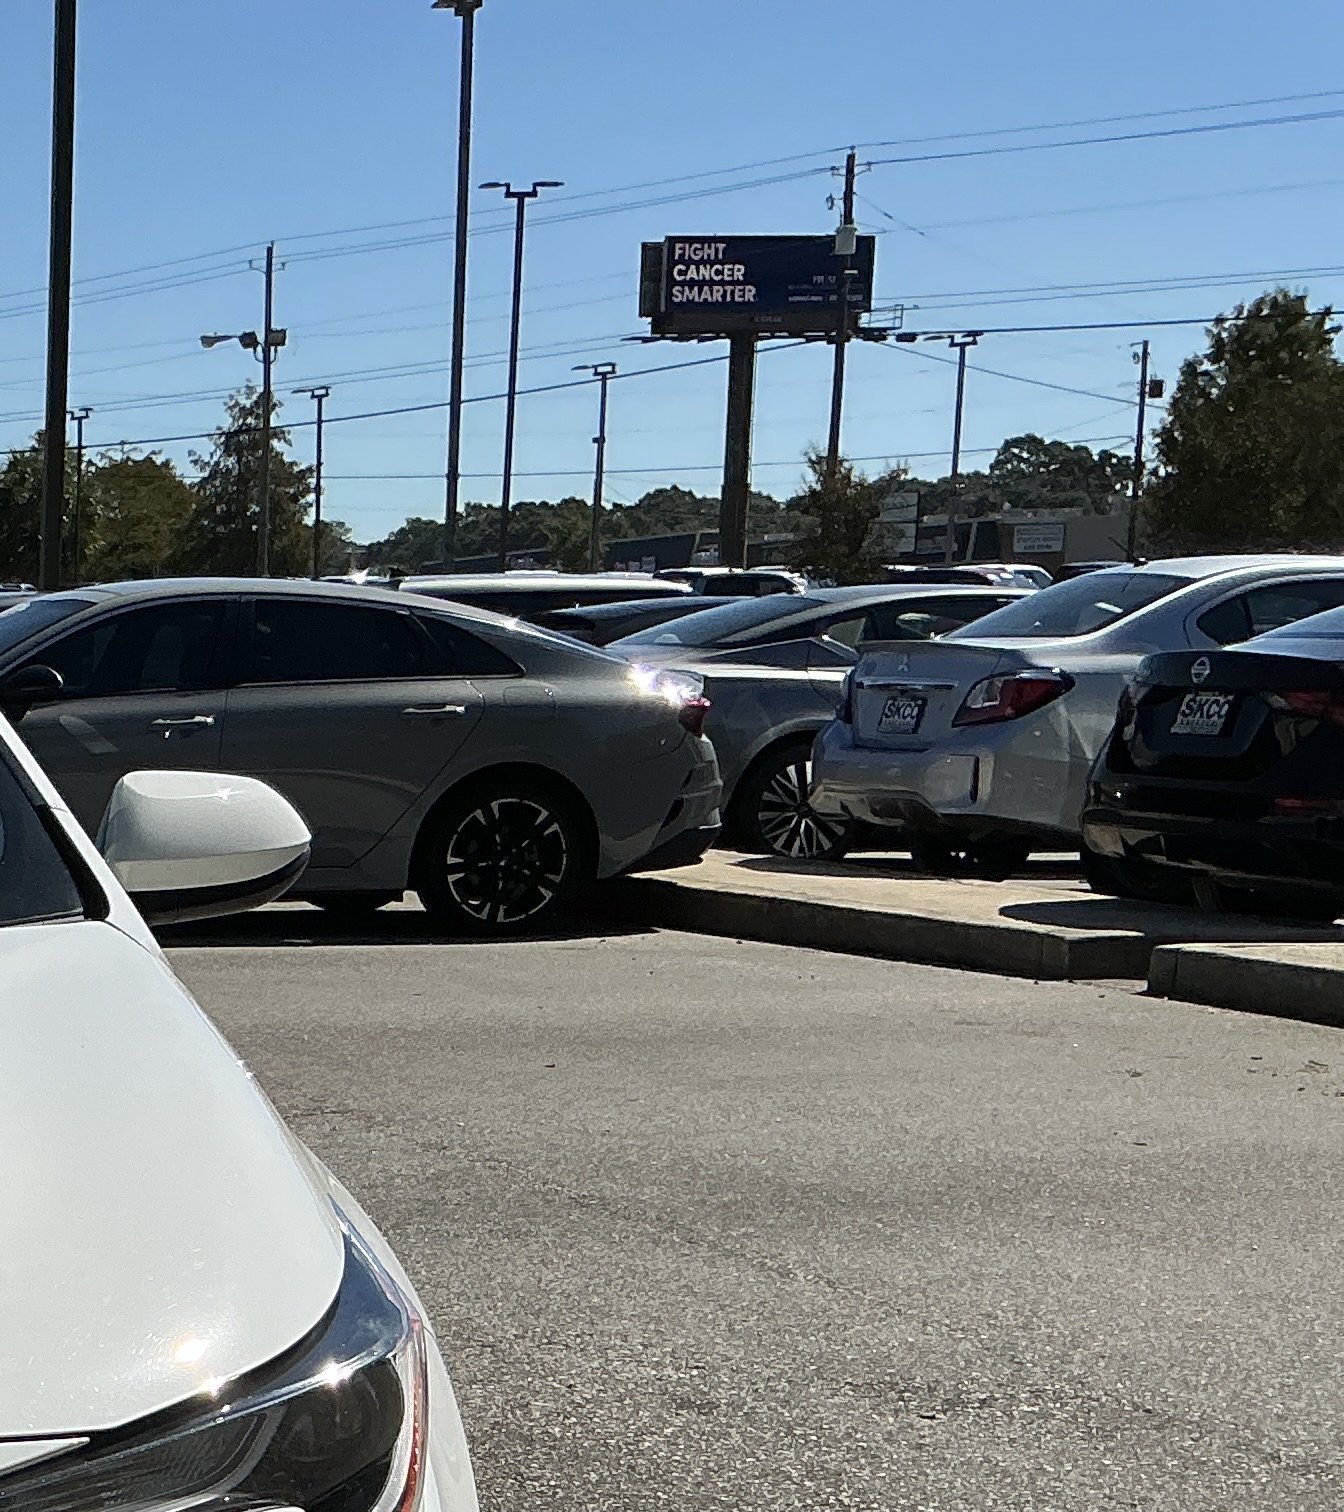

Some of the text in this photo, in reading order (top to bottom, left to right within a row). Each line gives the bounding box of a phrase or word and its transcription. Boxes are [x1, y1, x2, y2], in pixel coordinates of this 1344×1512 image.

[674, 243, 726, 260] FIGHT
[673, 264, 745, 281] CANCER
[672, 285, 757, 302] SMARTER
